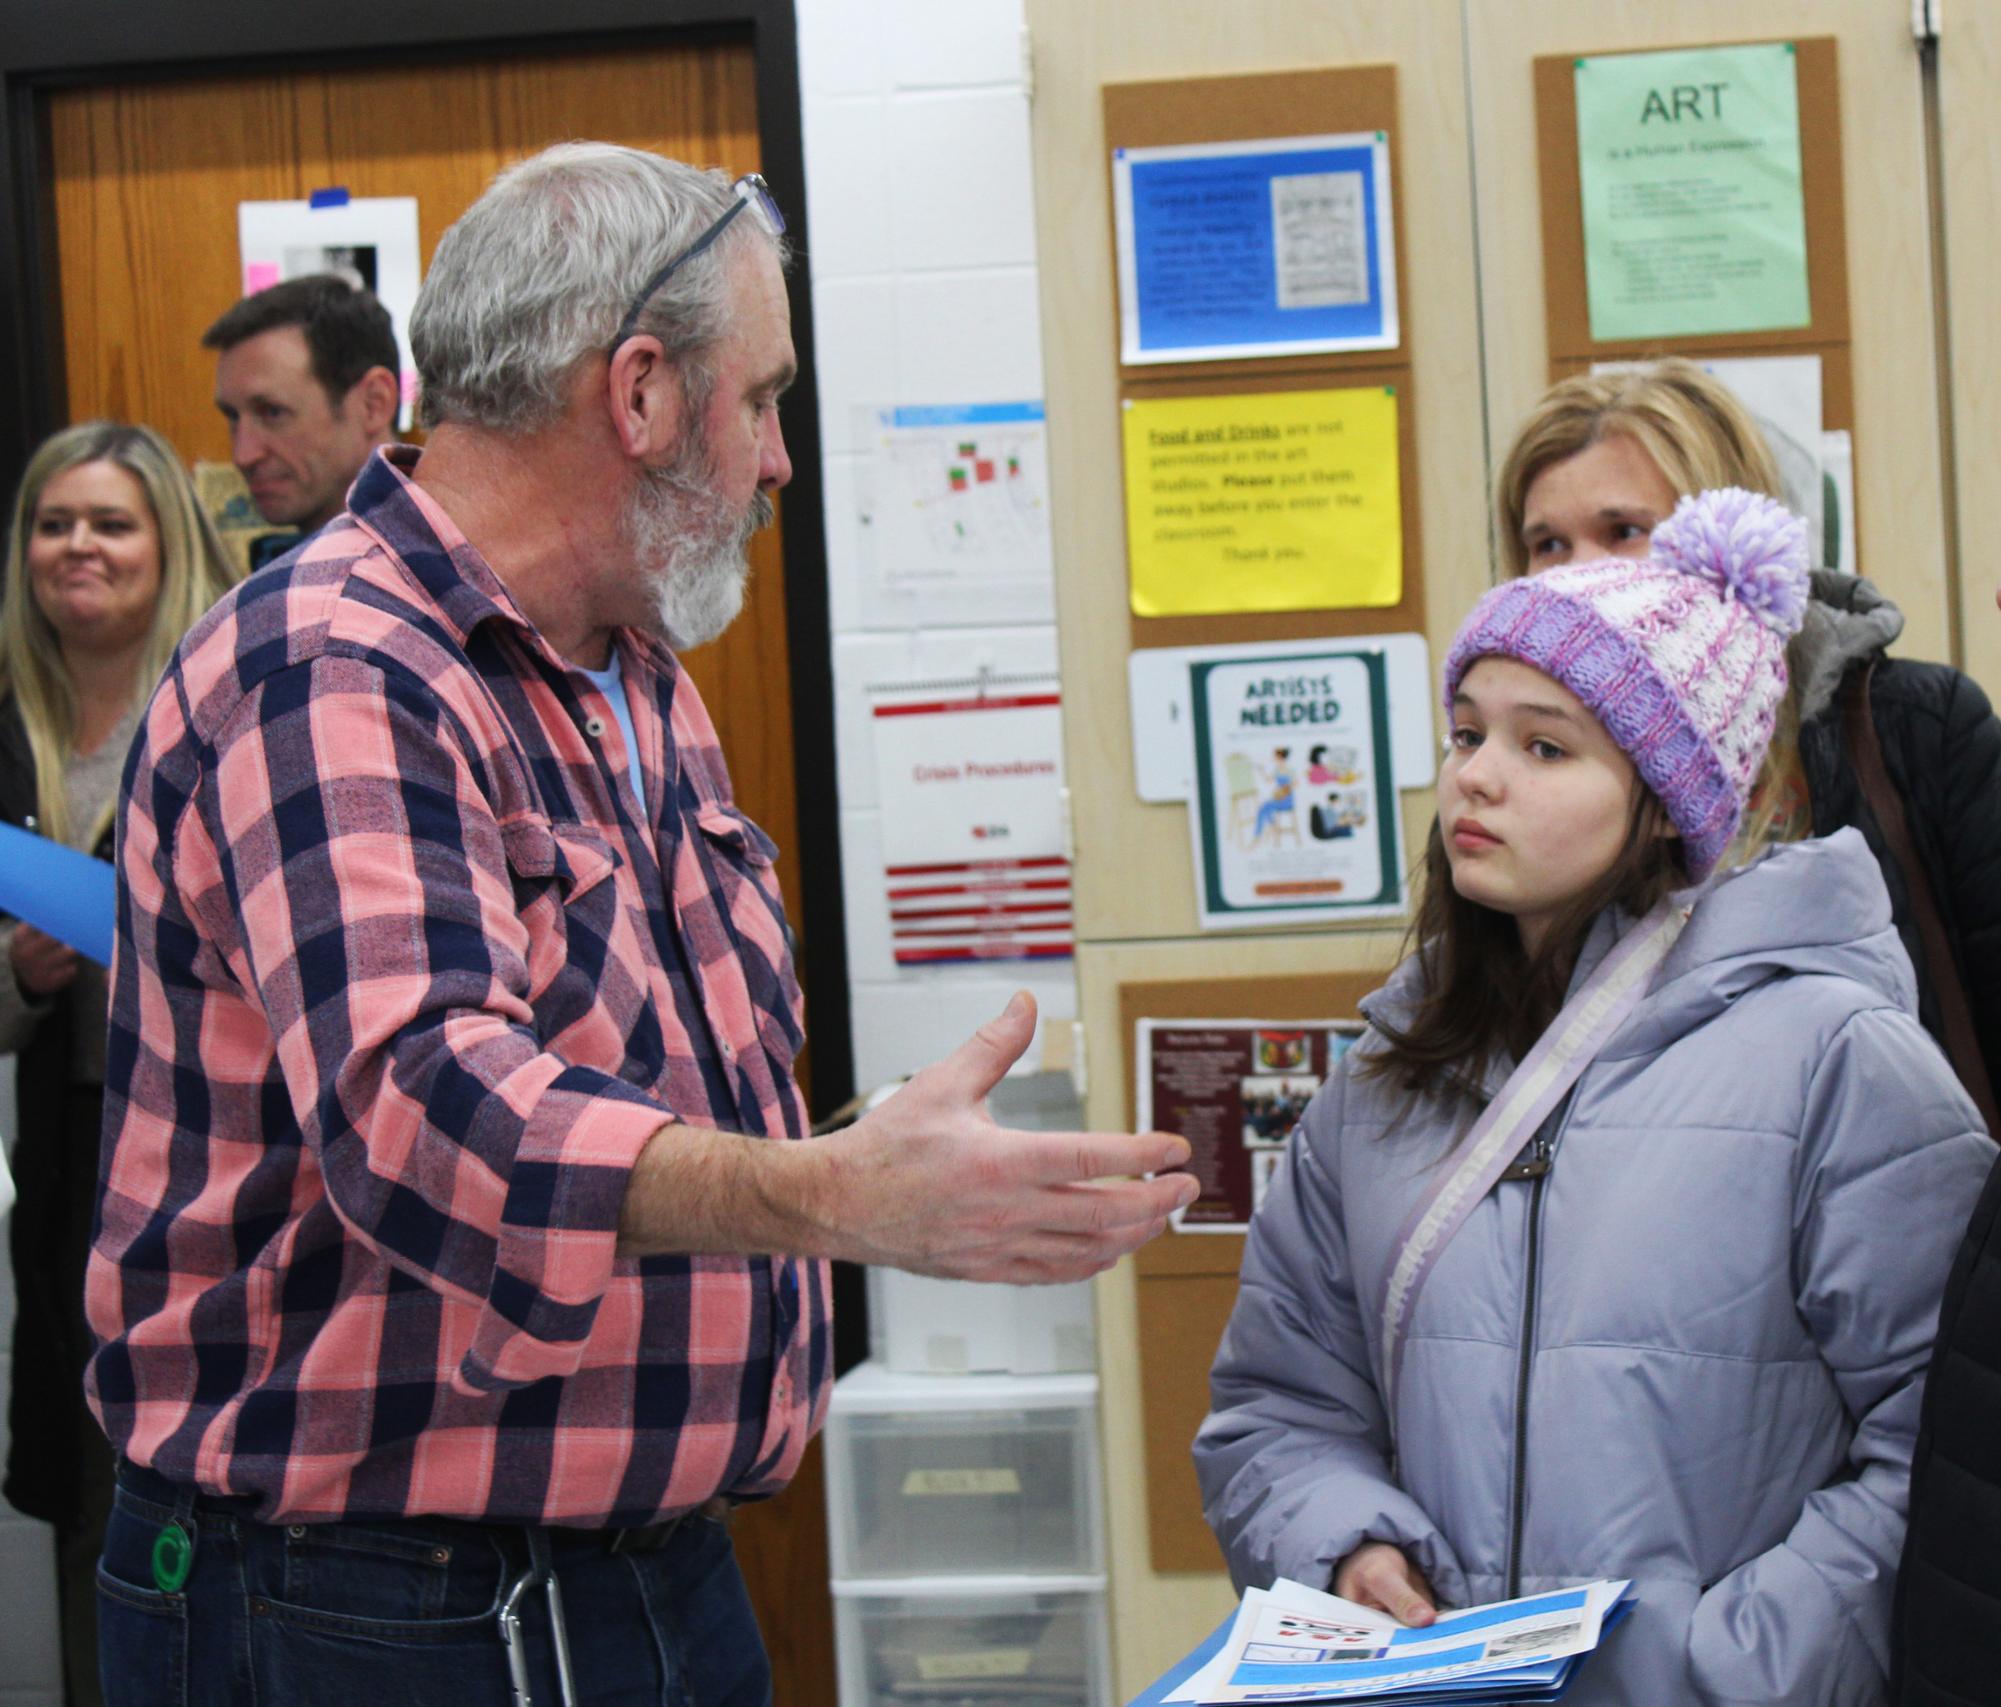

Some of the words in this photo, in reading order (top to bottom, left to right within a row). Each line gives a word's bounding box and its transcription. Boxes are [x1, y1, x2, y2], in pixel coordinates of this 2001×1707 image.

[1640, 82, 1730, 125] ART
[1148, 427, 1189, 446] Food
[1194, 426, 1223, 444] and
[1228, 423, 1281, 442] Drinks
[1286, 423, 1310, 436] are
[1316, 421, 1343, 434] not
[1151, 450, 1230, 468] permitted
[1235, 449, 1248, 462] in
[1253, 448, 1280, 462] the
[1285, 447, 1308, 461] art
[1222, 474, 1274, 488] Please
[1280, 472, 1306, 488] put
[1154, 503, 1193, 519] away
[1199, 499, 1249, 516] before
[1335, 495, 1362, 509] the
[1222, 546, 1269, 562] Thank
[1245, 674, 1334, 700] ARTISTS
[1239, 701, 1341, 727] NEEDED
[914, 763, 960, 783] Crisis
[965, 759, 1056, 778] Procedures
